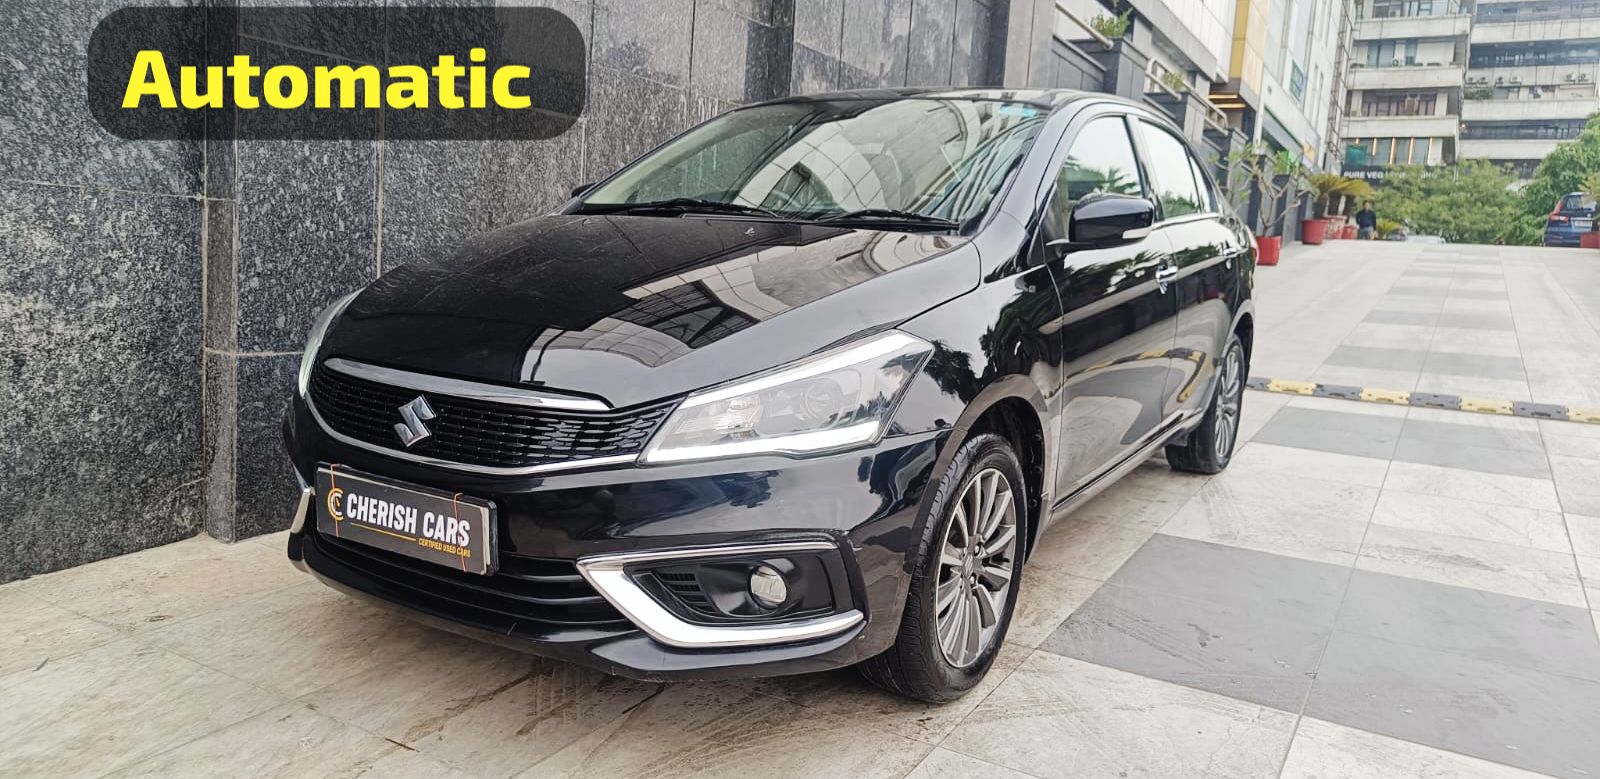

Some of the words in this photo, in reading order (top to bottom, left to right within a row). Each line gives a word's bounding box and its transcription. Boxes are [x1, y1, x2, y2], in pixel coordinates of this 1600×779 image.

[1343, 171, 1365, 179] PURE
[346, 493, 418, 534] CHERISH
[422, 511, 471, 547] CARS
[418, 538, 442, 551] CERTIFIED
[442, 543, 457, 555] USED
[456, 546, 471, 558] CARS
